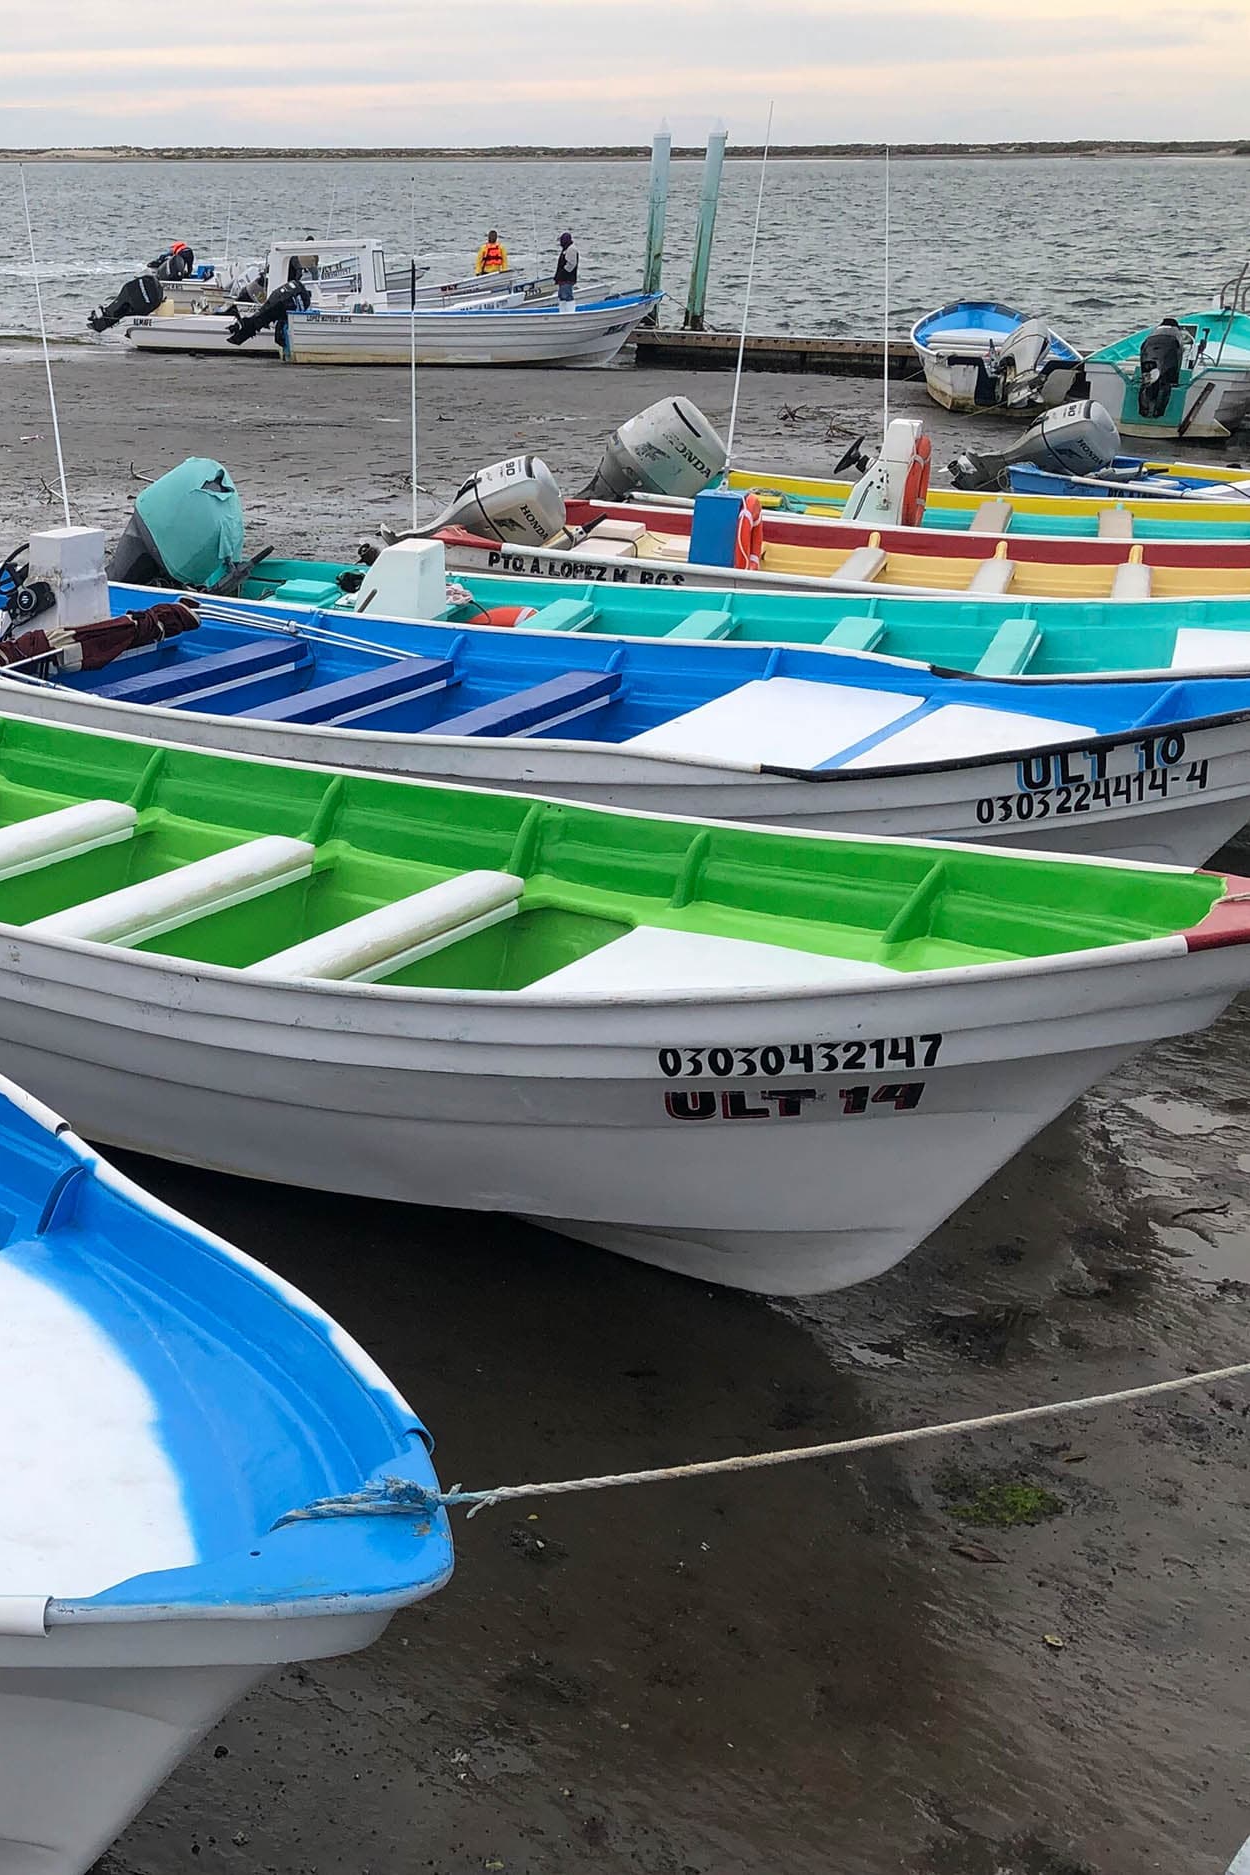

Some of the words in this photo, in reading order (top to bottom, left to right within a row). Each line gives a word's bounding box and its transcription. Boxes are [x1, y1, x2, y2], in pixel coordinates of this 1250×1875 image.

[520, 503, 549, 540] HONDA
[548, 561, 607, 582] LOPEZ
[1015, 747, 1115, 793] ULT
[1134, 732, 1186, 772] 10
[658, 1032, 943, 1078] 03030432147
[664, 1088, 818, 1121] ULT
[838, 1081, 926, 1115] 14
